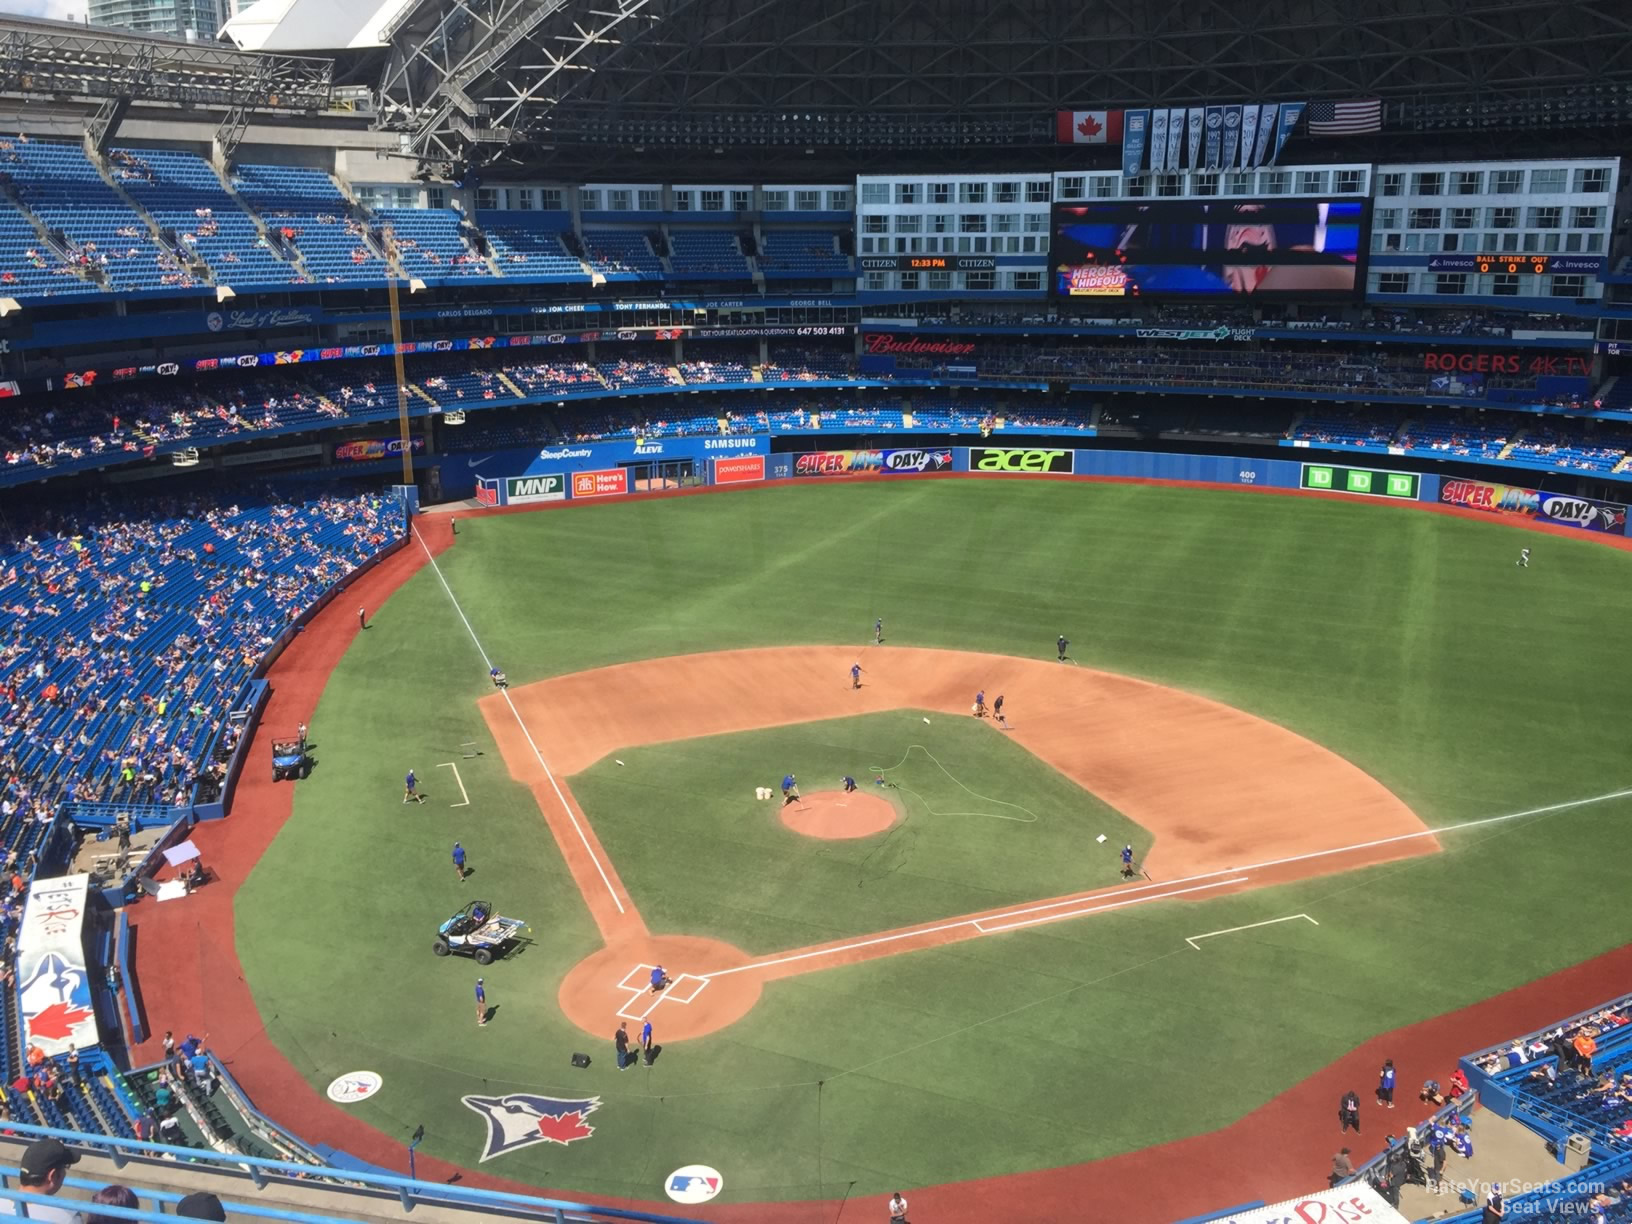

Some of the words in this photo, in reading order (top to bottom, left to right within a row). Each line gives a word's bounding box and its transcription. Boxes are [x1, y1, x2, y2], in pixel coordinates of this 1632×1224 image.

[861, 259, 898, 268] CITIZEN
[911, 259, 931, 268] 12:33
[932, 259, 946, 268] PM
[958, 259, 995, 268] CITIZEN
[1442, 259, 1475, 268] Invesco
[1476, 255, 1496, 263] BALL
[1499, 255, 1527, 263] STRIKE
[1530, 256, 1549, 264] OUT
[1480, 263, 1489, 273] 0
[1508, 264, 1517, 274] 0
[1535, 264, 1544, 274] 0
[1565, 260, 1600, 269] Invesco
[1072, 265, 1122, 279] HEROES
[1078, 275, 1127, 288] HIDEOUT
[437, 310, 462, 318] CARLOS
[463, 309, 493, 317] DELGADO
[711, 329, 725, 337] YOUR
[764, 328, 788, 336] QUESTION
[797, 328, 812, 336] 647
[813, 328, 828, 336] 503
[829, 327, 845, 335] 4131
[1231, 328, 1256, 336] FLIGHT
[865, 334, 977, 355] Budweiser
[1424, 352, 1521, 374] ROGERS
[1529, 356, 1559, 375] 4K
[1563, 357, 1595, 377] TV
[704, 438, 757, 449] SAMSUNG
[795, 452, 845, 473] SUPER
[891, 451, 926, 470] DAY!
[978, 449, 1065, 472] acer
[774, 465, 789, 474] 375
[596, 474, 624, 483] Here's
[1239, 471, 1256, 479] 400
[1312, 470, 1331, 484] TD
[1350, 473, 1369, 488] TD
[1391, 478, 1410, 493] TD
[515, 477, 557, 496] MNP
[596, 482, 619, 492] How.
[1442, 480, 1496, 506] SUPER
[1498, 487, 1540, 513] JAYS
[1550, 500, 1594, 520] DAY!
